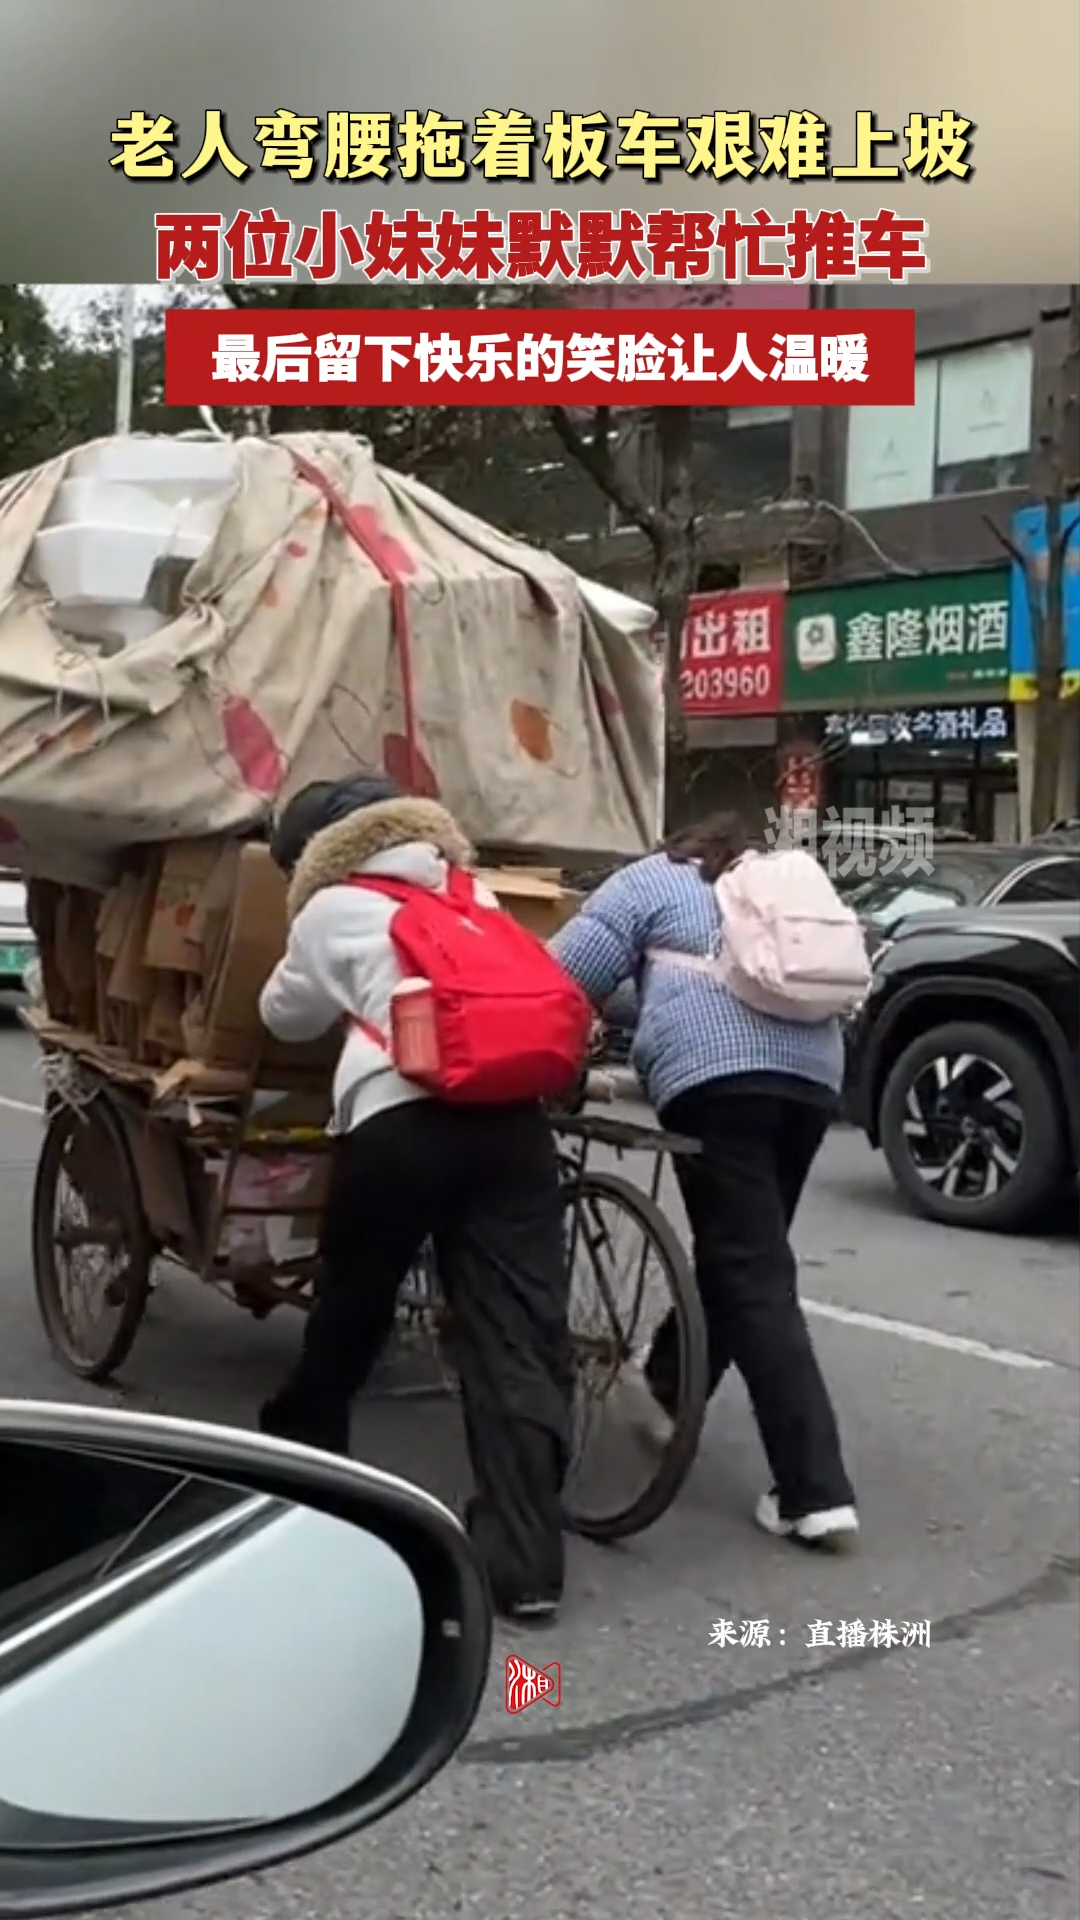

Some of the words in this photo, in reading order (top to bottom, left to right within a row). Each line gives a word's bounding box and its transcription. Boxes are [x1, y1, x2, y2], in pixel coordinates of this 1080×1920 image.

[680, 606, 771, 660] 出租
[846, 600, 1009, 663] 鑫隆烟酒
